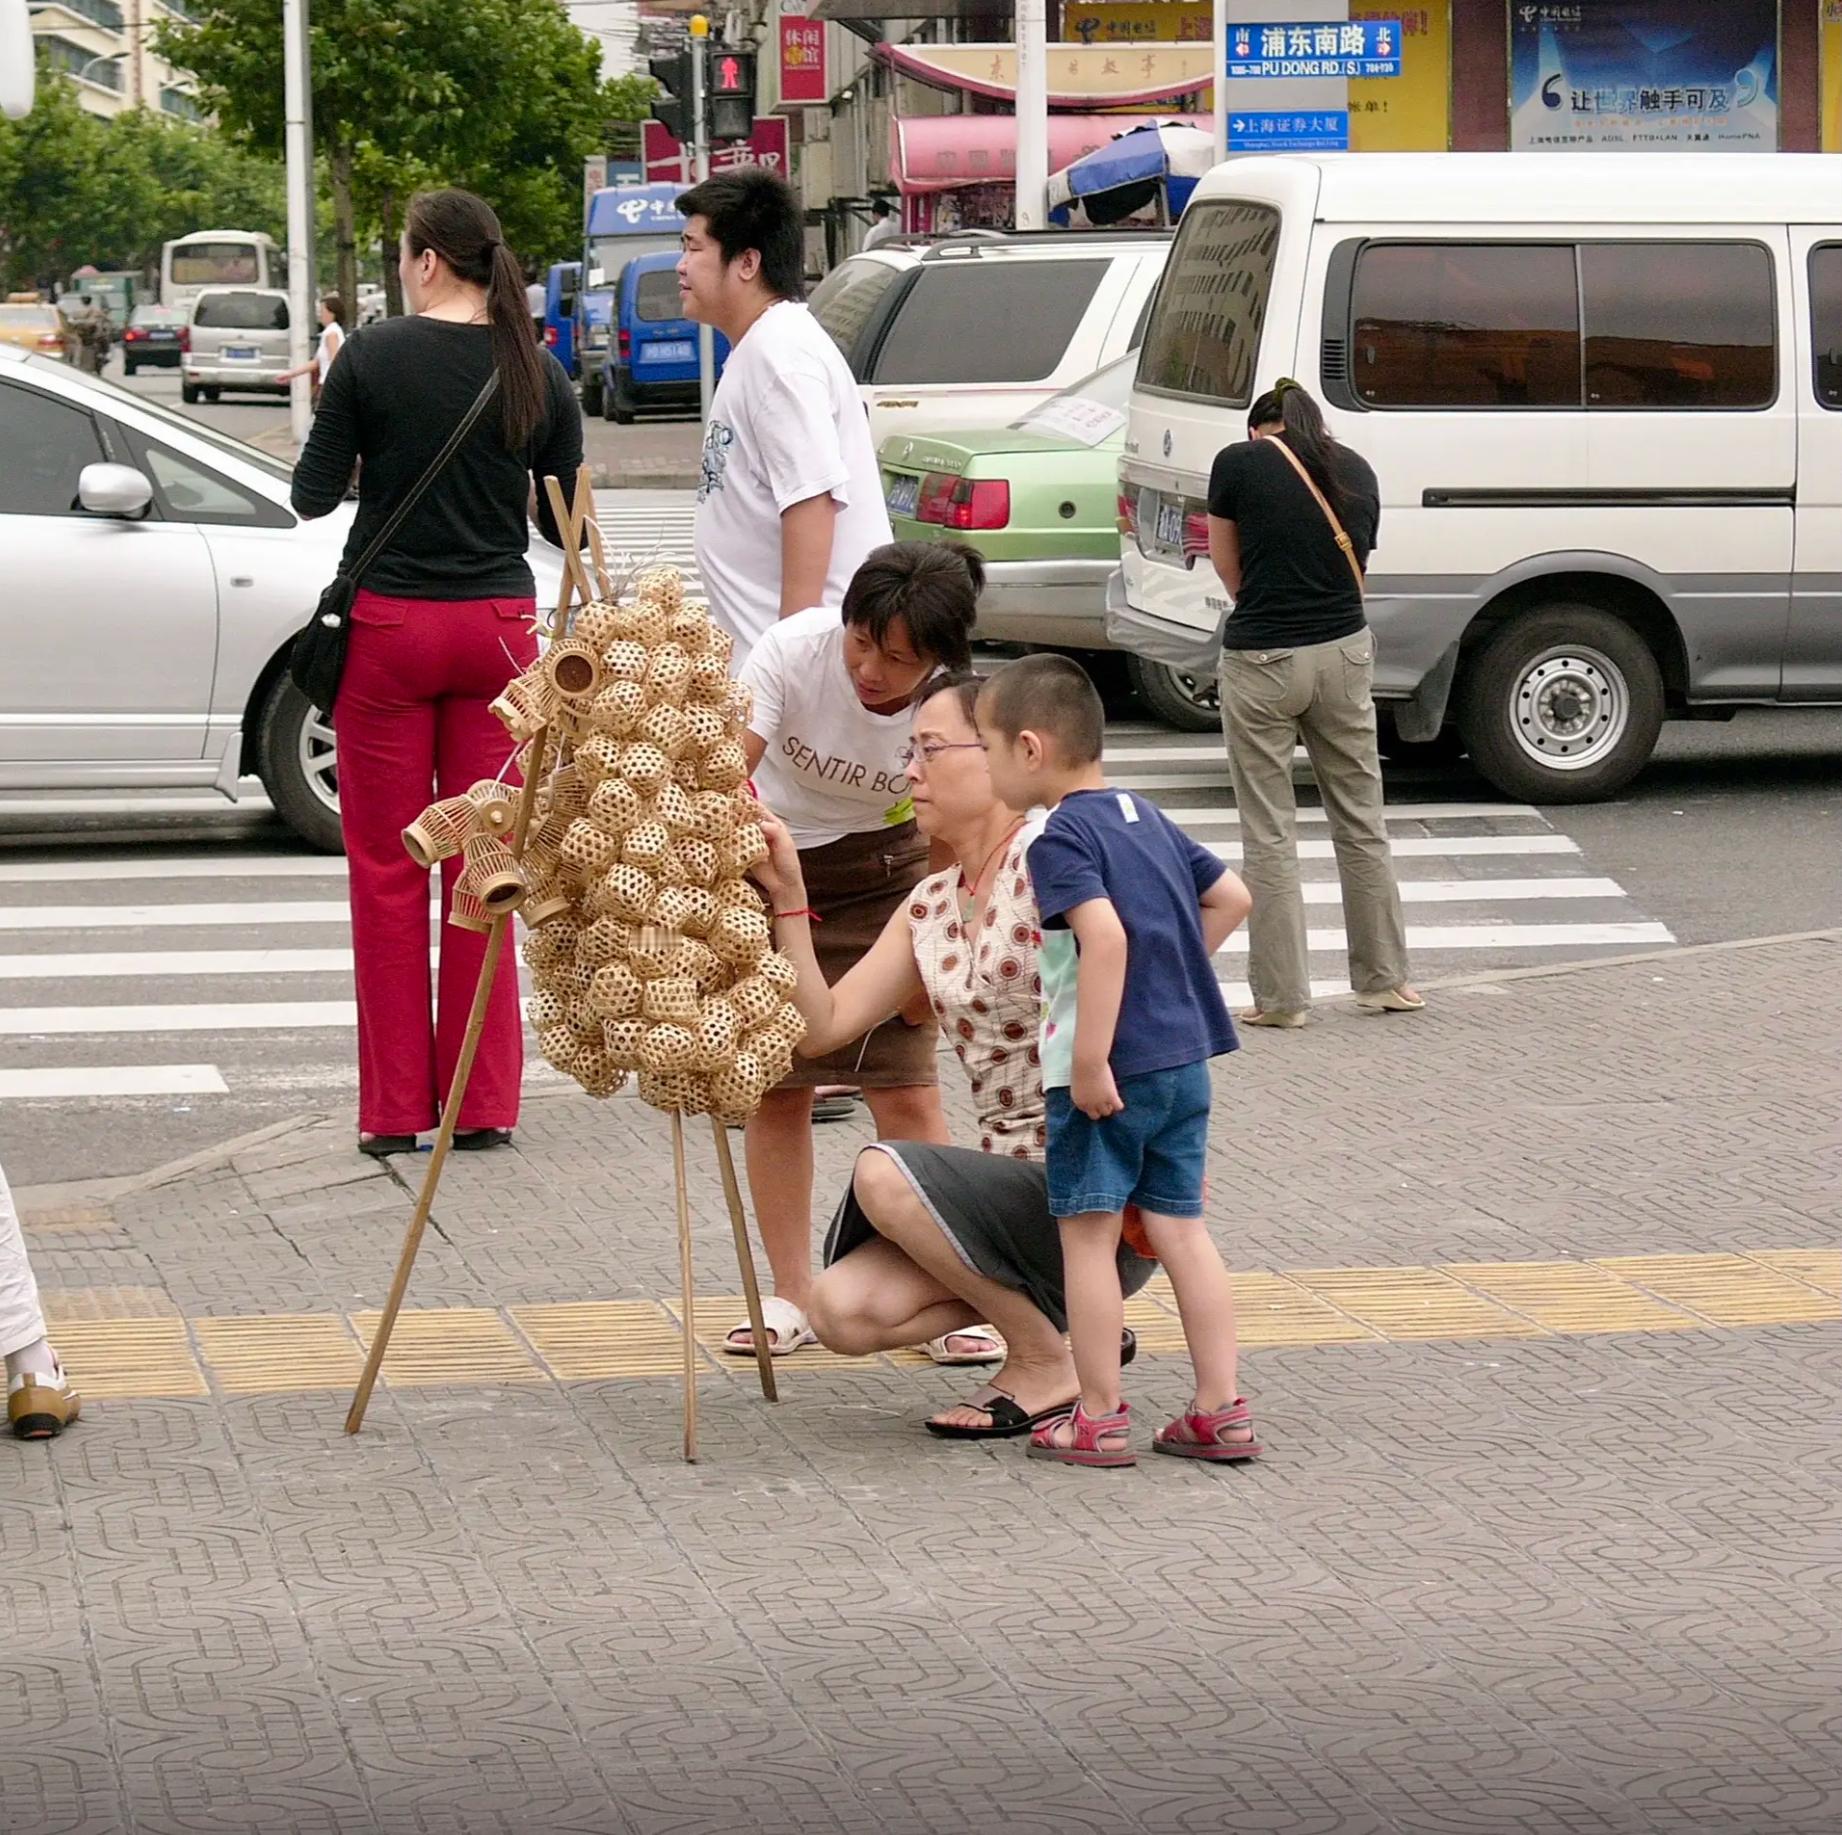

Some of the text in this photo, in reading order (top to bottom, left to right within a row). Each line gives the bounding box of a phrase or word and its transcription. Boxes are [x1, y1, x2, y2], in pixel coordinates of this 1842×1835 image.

[1261, 25, 1365, 57] 浦东南路
[1376, 28, 1391, 42] 北
[1262, 62, 1280, 75] PU
[1281, 62, 1319, 75] DONG
[1570, 88, 1729, 114] 让世界触手可及
[1244, 117, 1338, 133] 上海证券大厦
[782, 736, 867, 788] SENTIR
